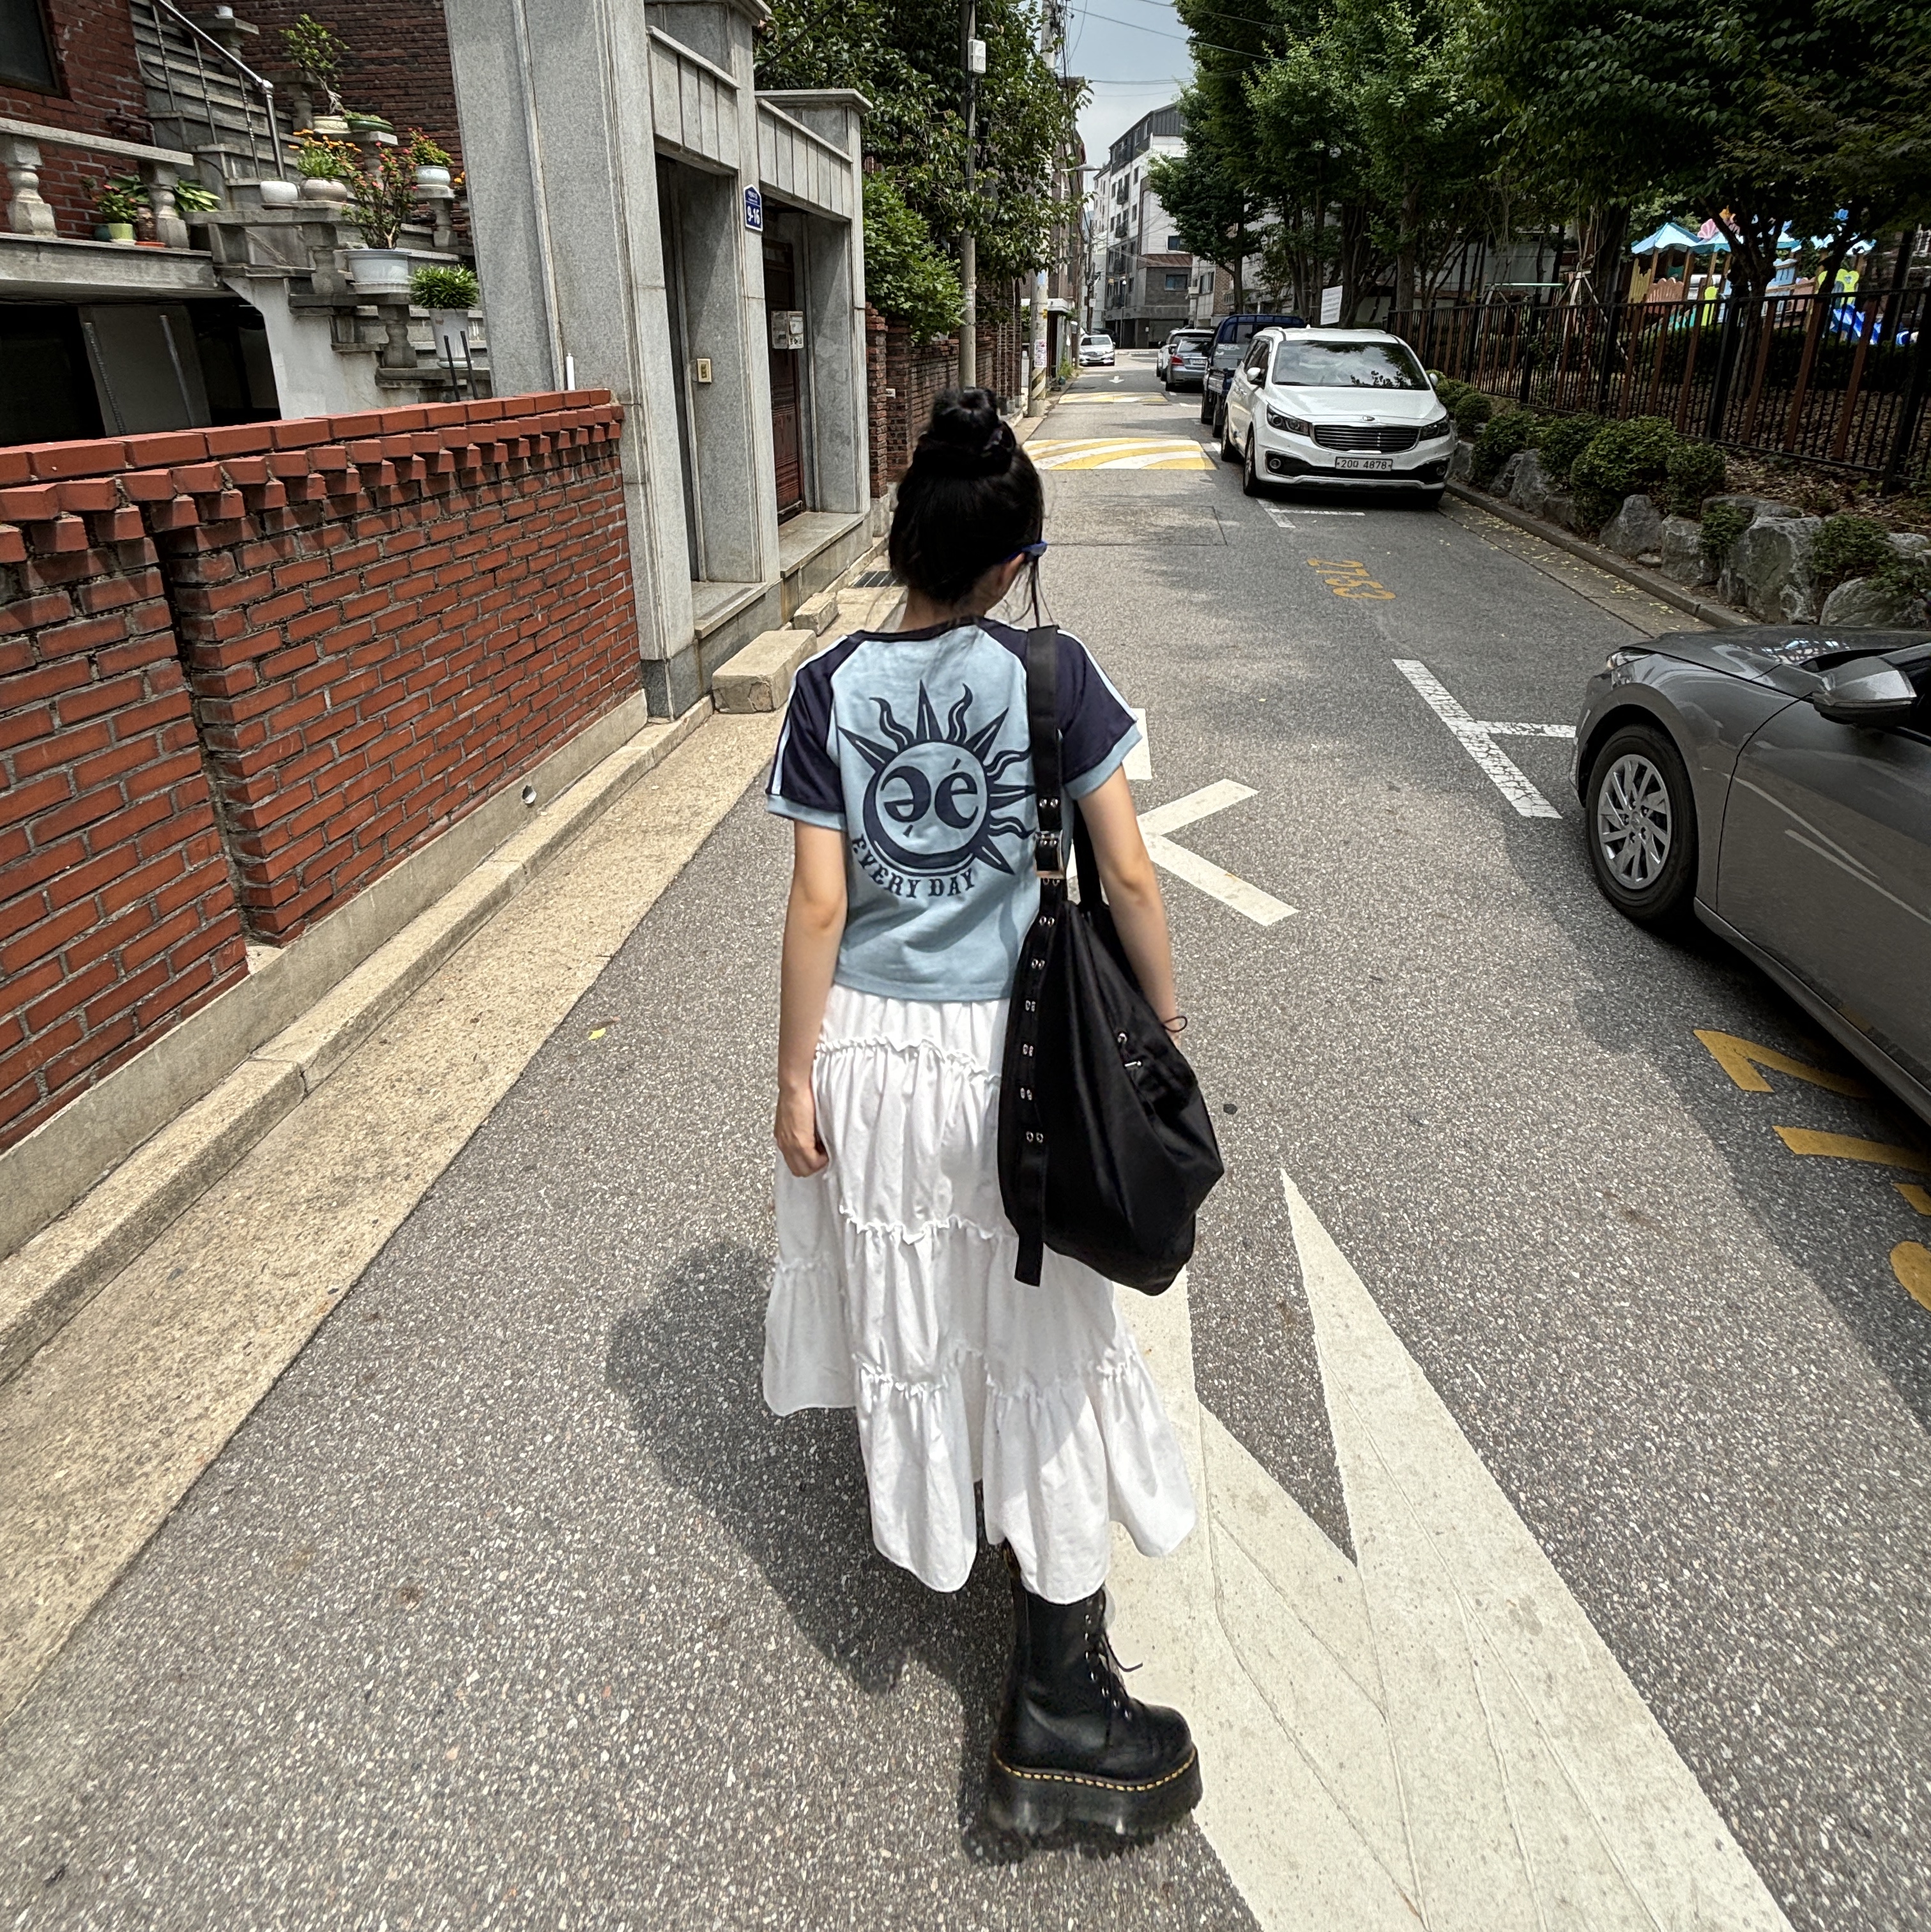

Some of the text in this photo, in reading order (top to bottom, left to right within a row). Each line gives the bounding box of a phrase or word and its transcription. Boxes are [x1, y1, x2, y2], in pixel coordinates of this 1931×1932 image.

[747, 205, 760, 224] 9-16
[1363, 461, 1387, 470] 4878
[852, 835, 975, 898] EVERY DAY
